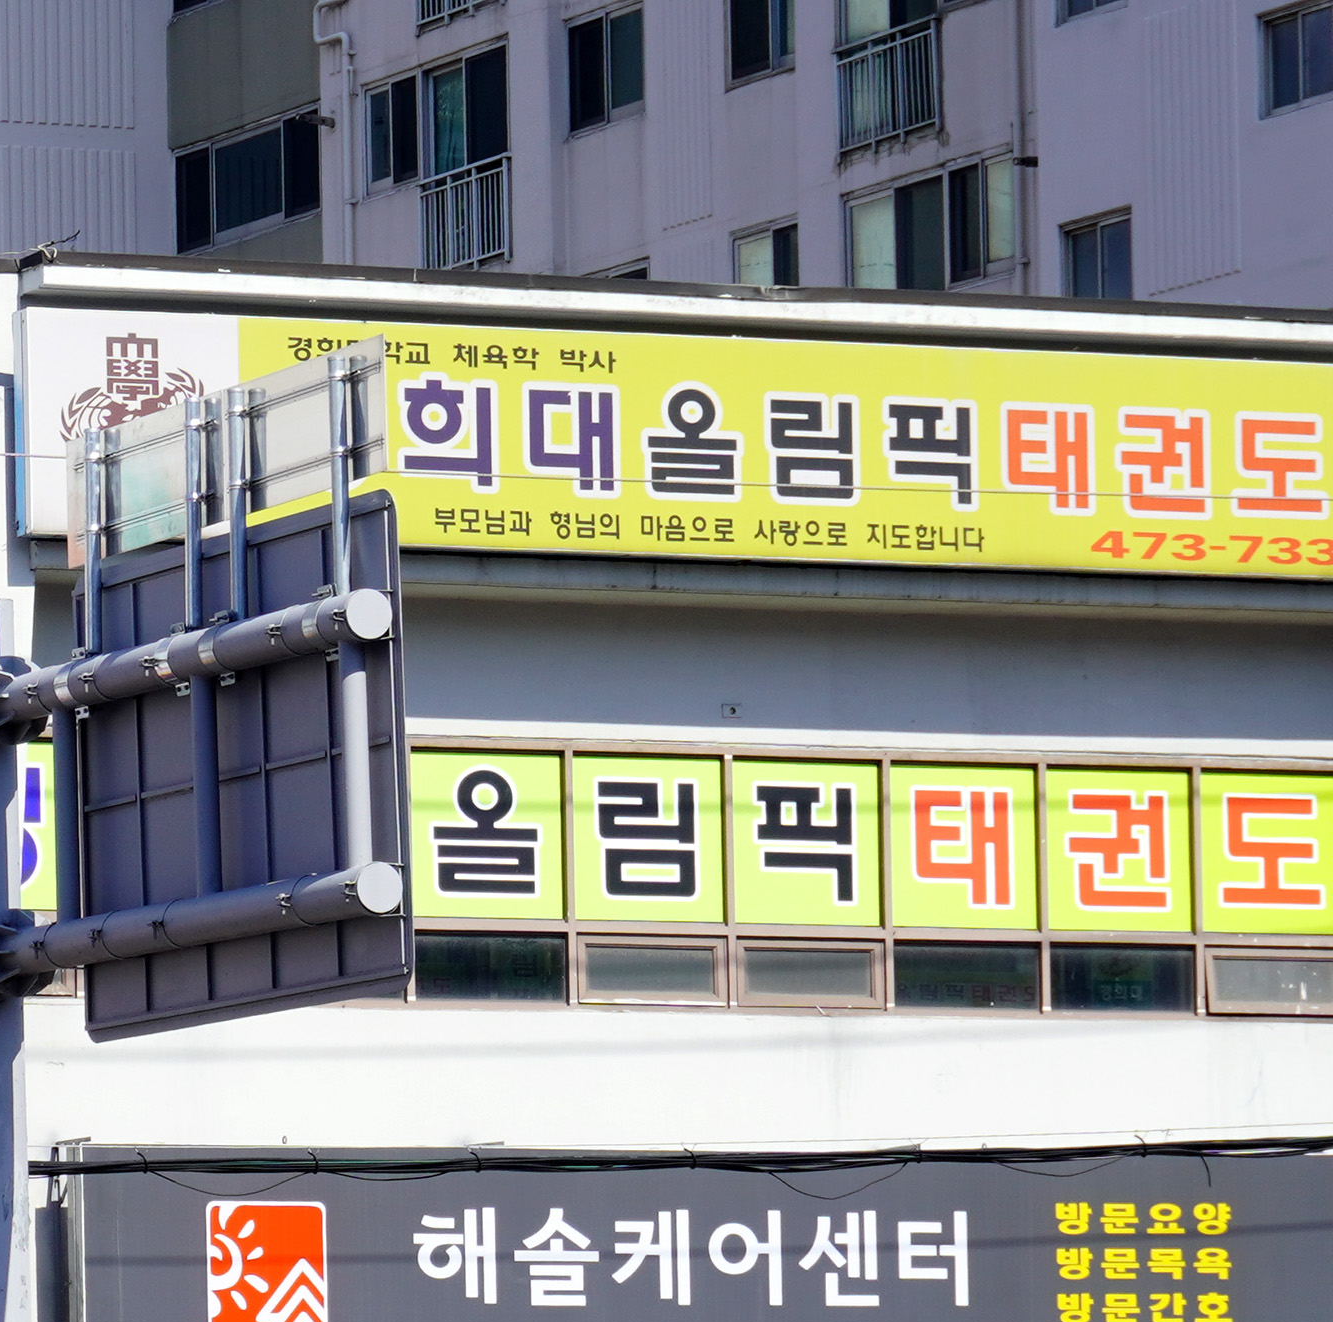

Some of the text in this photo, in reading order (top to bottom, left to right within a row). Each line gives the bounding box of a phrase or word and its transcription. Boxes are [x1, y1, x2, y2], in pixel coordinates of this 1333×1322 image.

[454, 343, 539, 370] 체육학
[560, 348, 616, 373] 박사
[434, 507, 984, 552] 부모님과 형님의 마음으로 사랑으로 지도합니다
[1055, 1203, 1231, 1236] 방문요양
[413, 1207, 969, 1307] 해솔케어센터
[1055, 1247, 1232, 1281] 방문목욕
